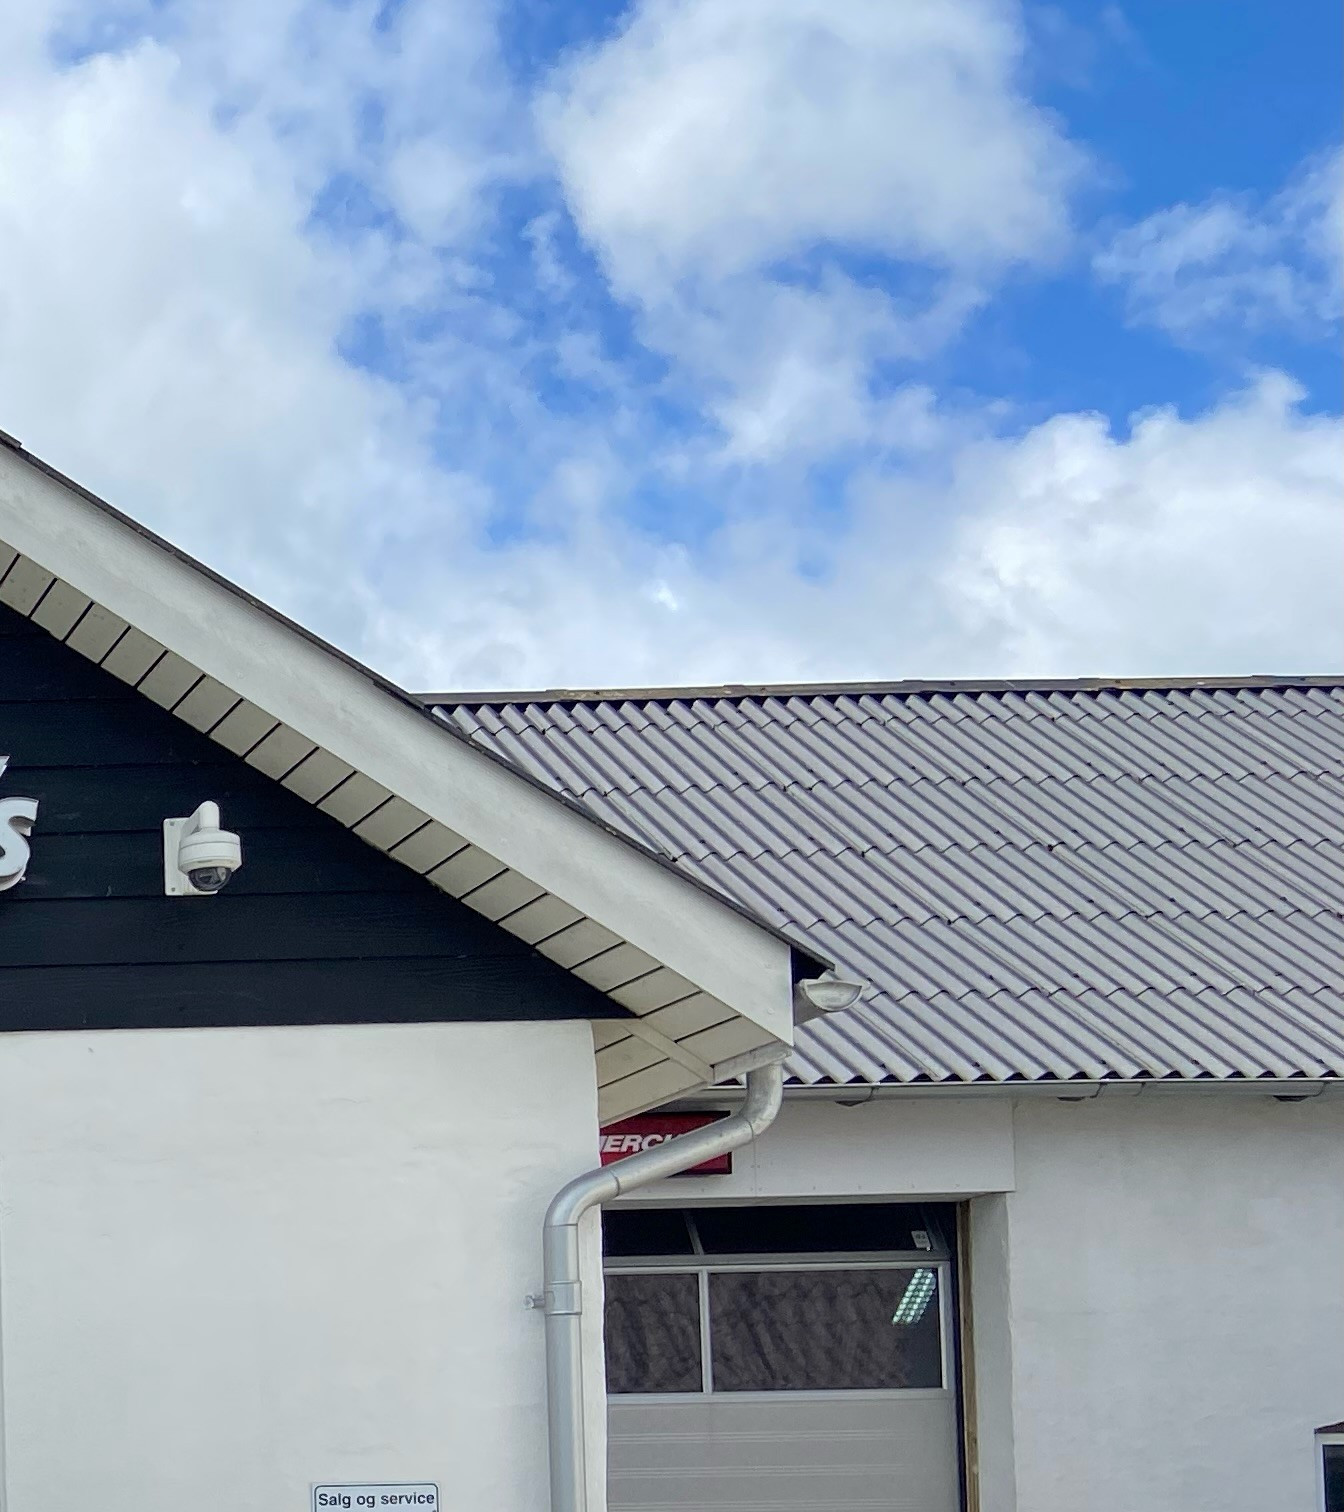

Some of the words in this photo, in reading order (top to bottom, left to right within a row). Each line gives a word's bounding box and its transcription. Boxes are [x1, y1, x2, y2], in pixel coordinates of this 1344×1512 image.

[318, 1492, 351, 1508] Salg
[356, 1495, 375, 1508] og
[381, 1492, 435, 1505] service
